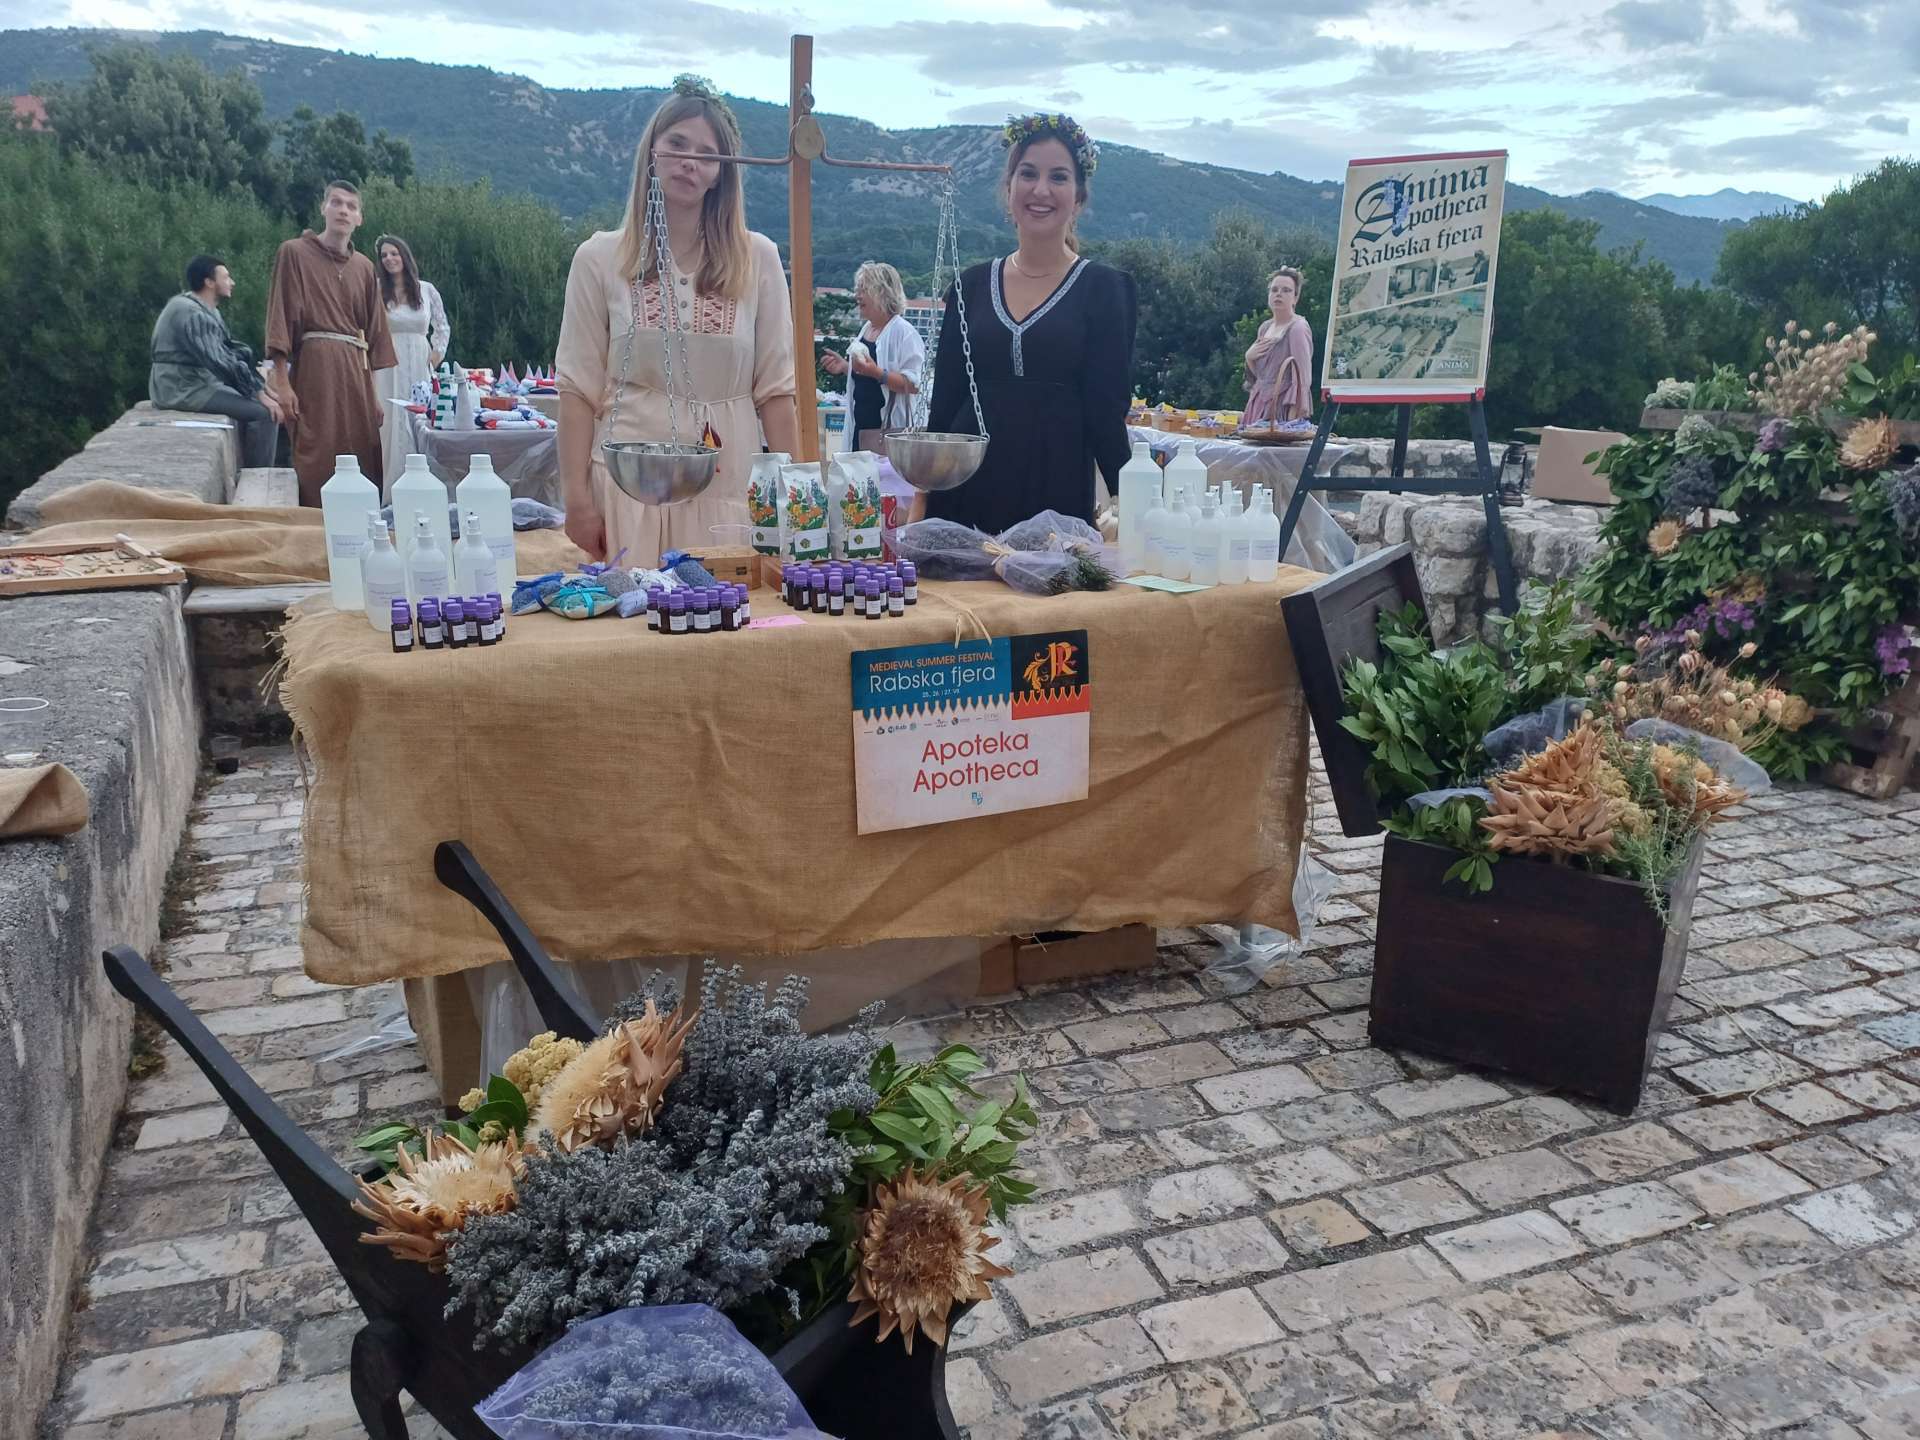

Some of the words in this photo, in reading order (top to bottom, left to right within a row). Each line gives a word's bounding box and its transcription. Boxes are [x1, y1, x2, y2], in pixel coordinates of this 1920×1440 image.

[1350, 165, 1489, 248] Anima
[1349, 236, 1431, 269] Rabska
[1437, 225, 1483, 251] fjera
[1437, 359, 1470, 370] ANIMA
[869, 659, 914, 673] MEDIEVAL
[916, 655, 956, 668] SUMMER
[958, 651, 995, 663] FESTIVAL
[870, 669, 945, 694] Rabska
[951, 666, 996, 687] fjera
[922, 731, 1029, 765] Apoteka
[913, 759, 1039, 794] Apotheca
